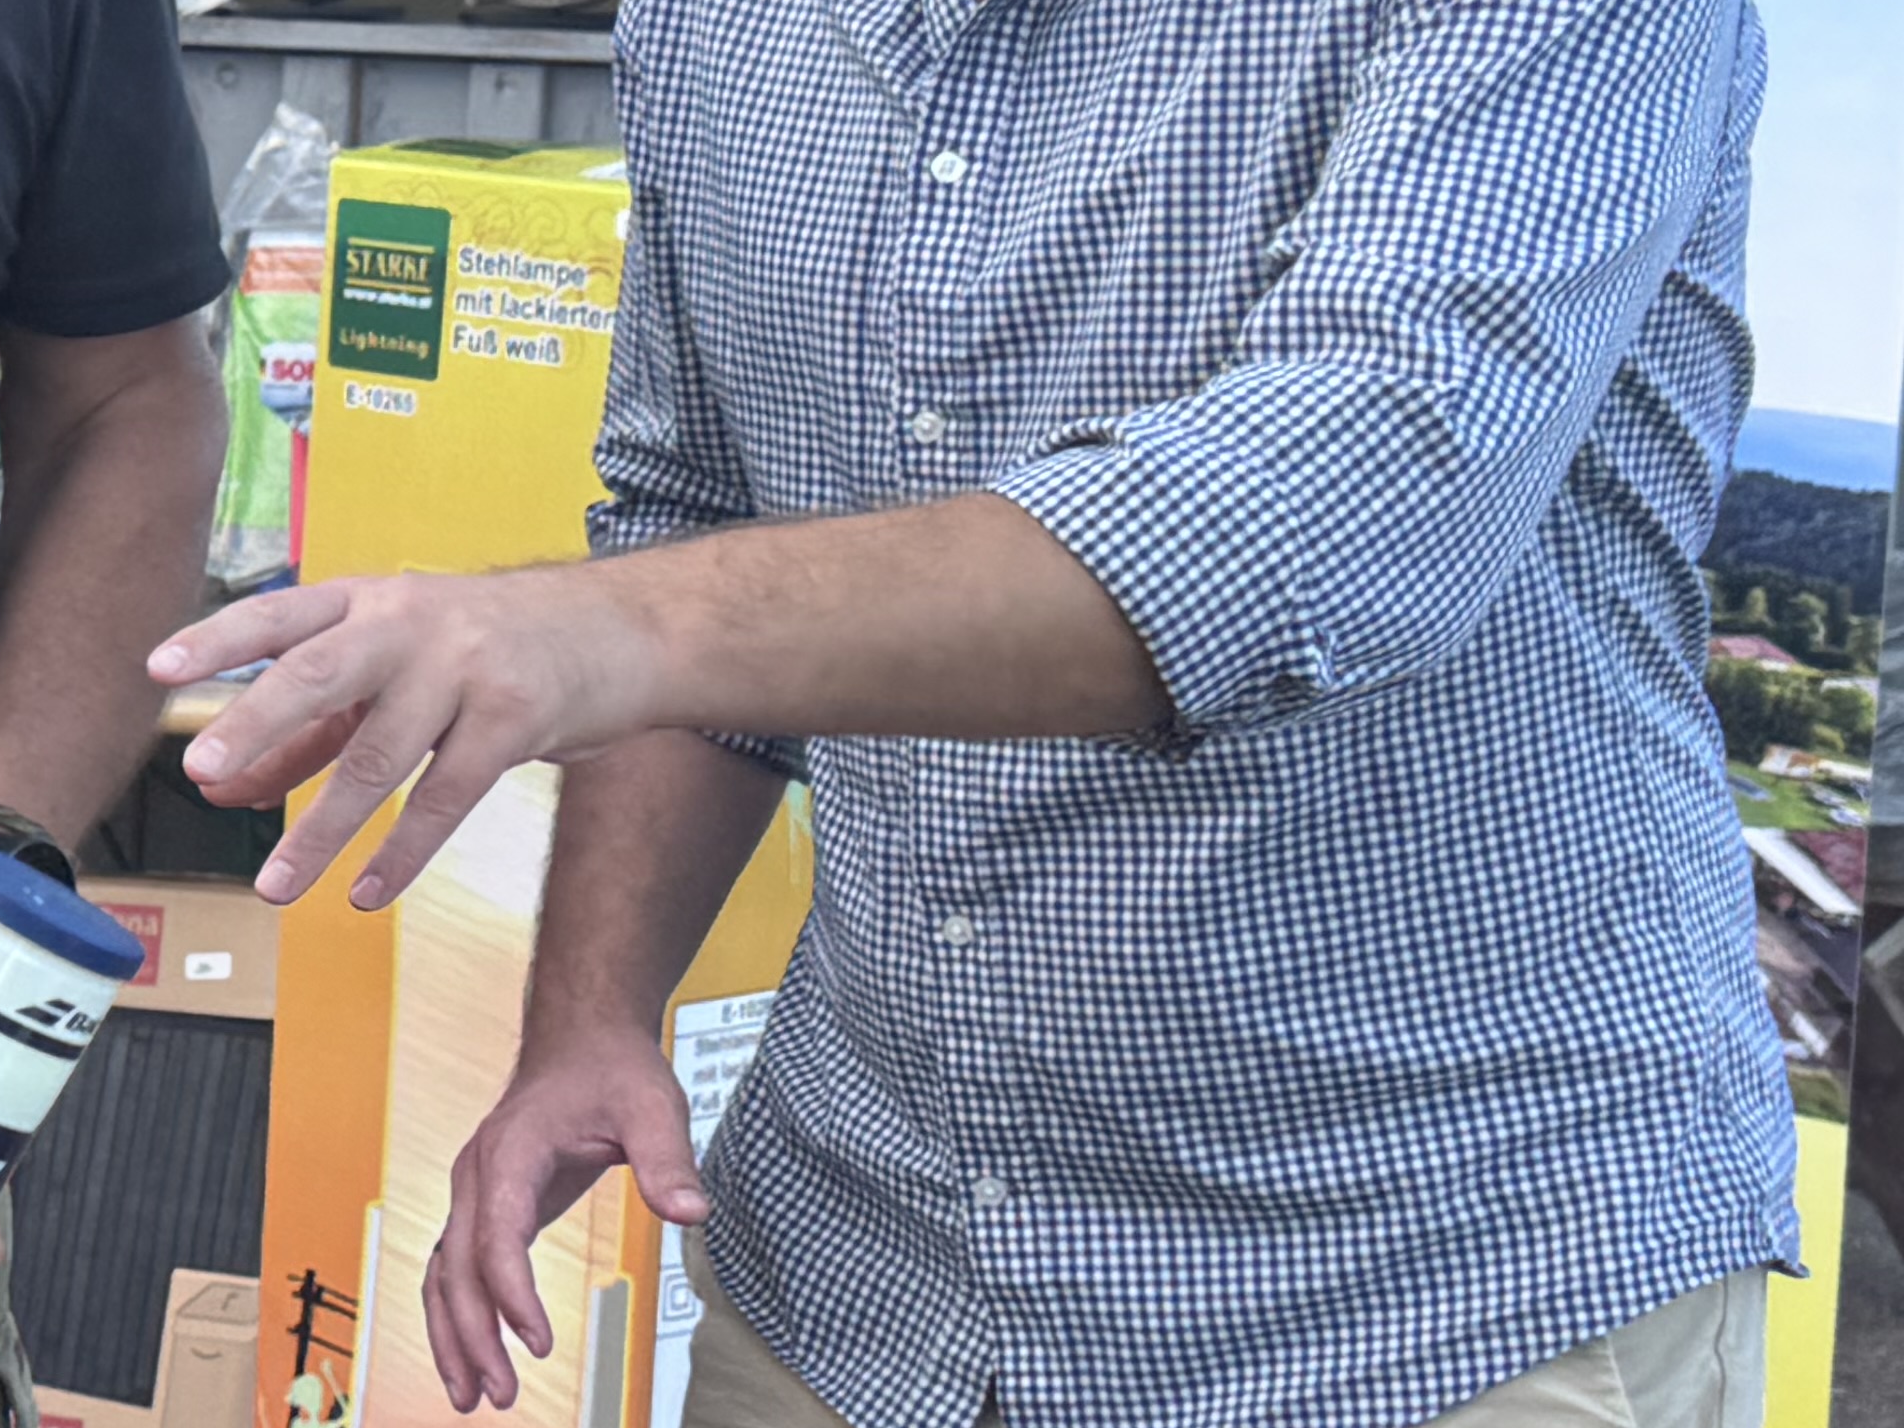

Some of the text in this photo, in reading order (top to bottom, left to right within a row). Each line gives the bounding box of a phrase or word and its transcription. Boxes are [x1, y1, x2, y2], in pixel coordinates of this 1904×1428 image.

[458, 246, 587, 290] Stehlampe
[455, 291, 493, 316] mit
[452, 324, 562, 365] Fuß weiß
